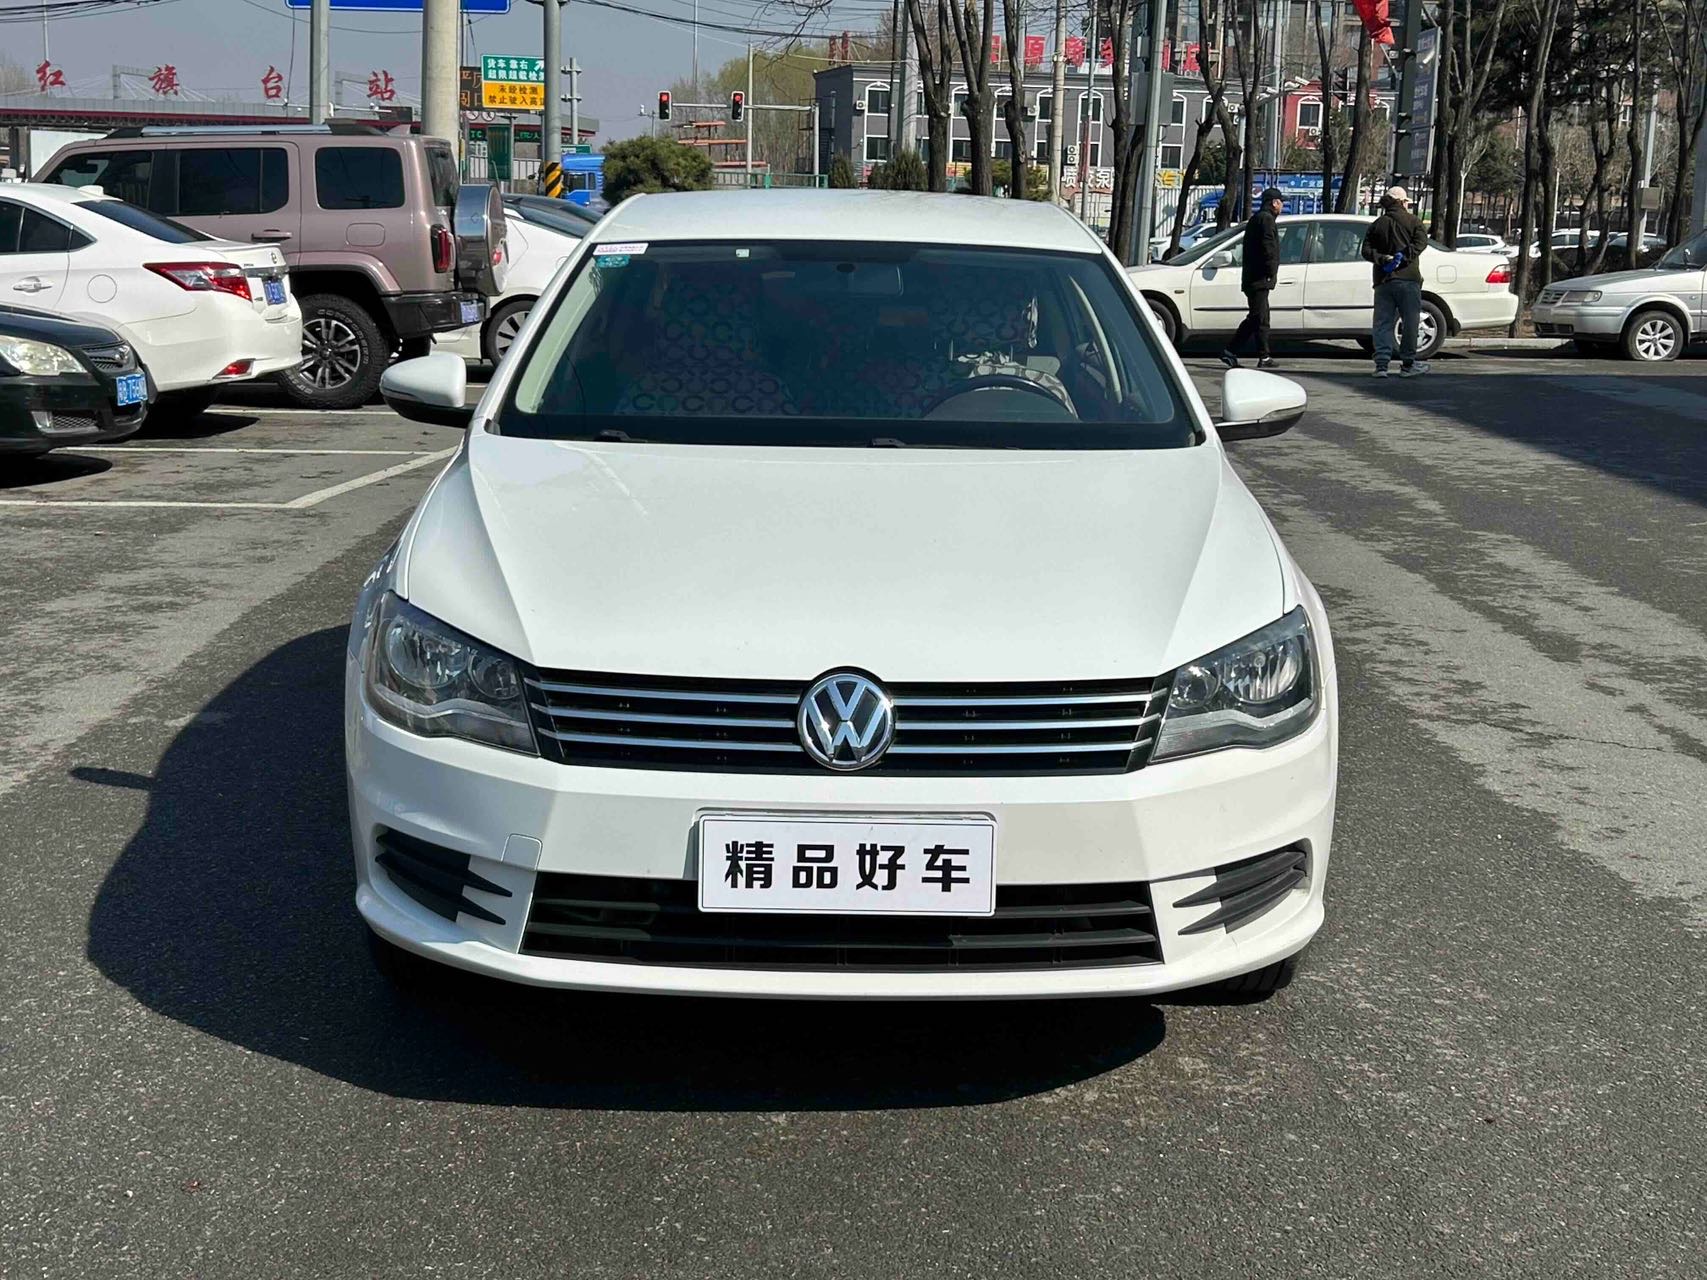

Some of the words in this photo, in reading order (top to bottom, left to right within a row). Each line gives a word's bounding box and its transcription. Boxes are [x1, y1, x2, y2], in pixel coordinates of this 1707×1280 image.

[36, 59, 396, 103] 红旗台站
[499, 85, 538, 95] 未经检测
[724, 840, 971, 892] 精品好车
